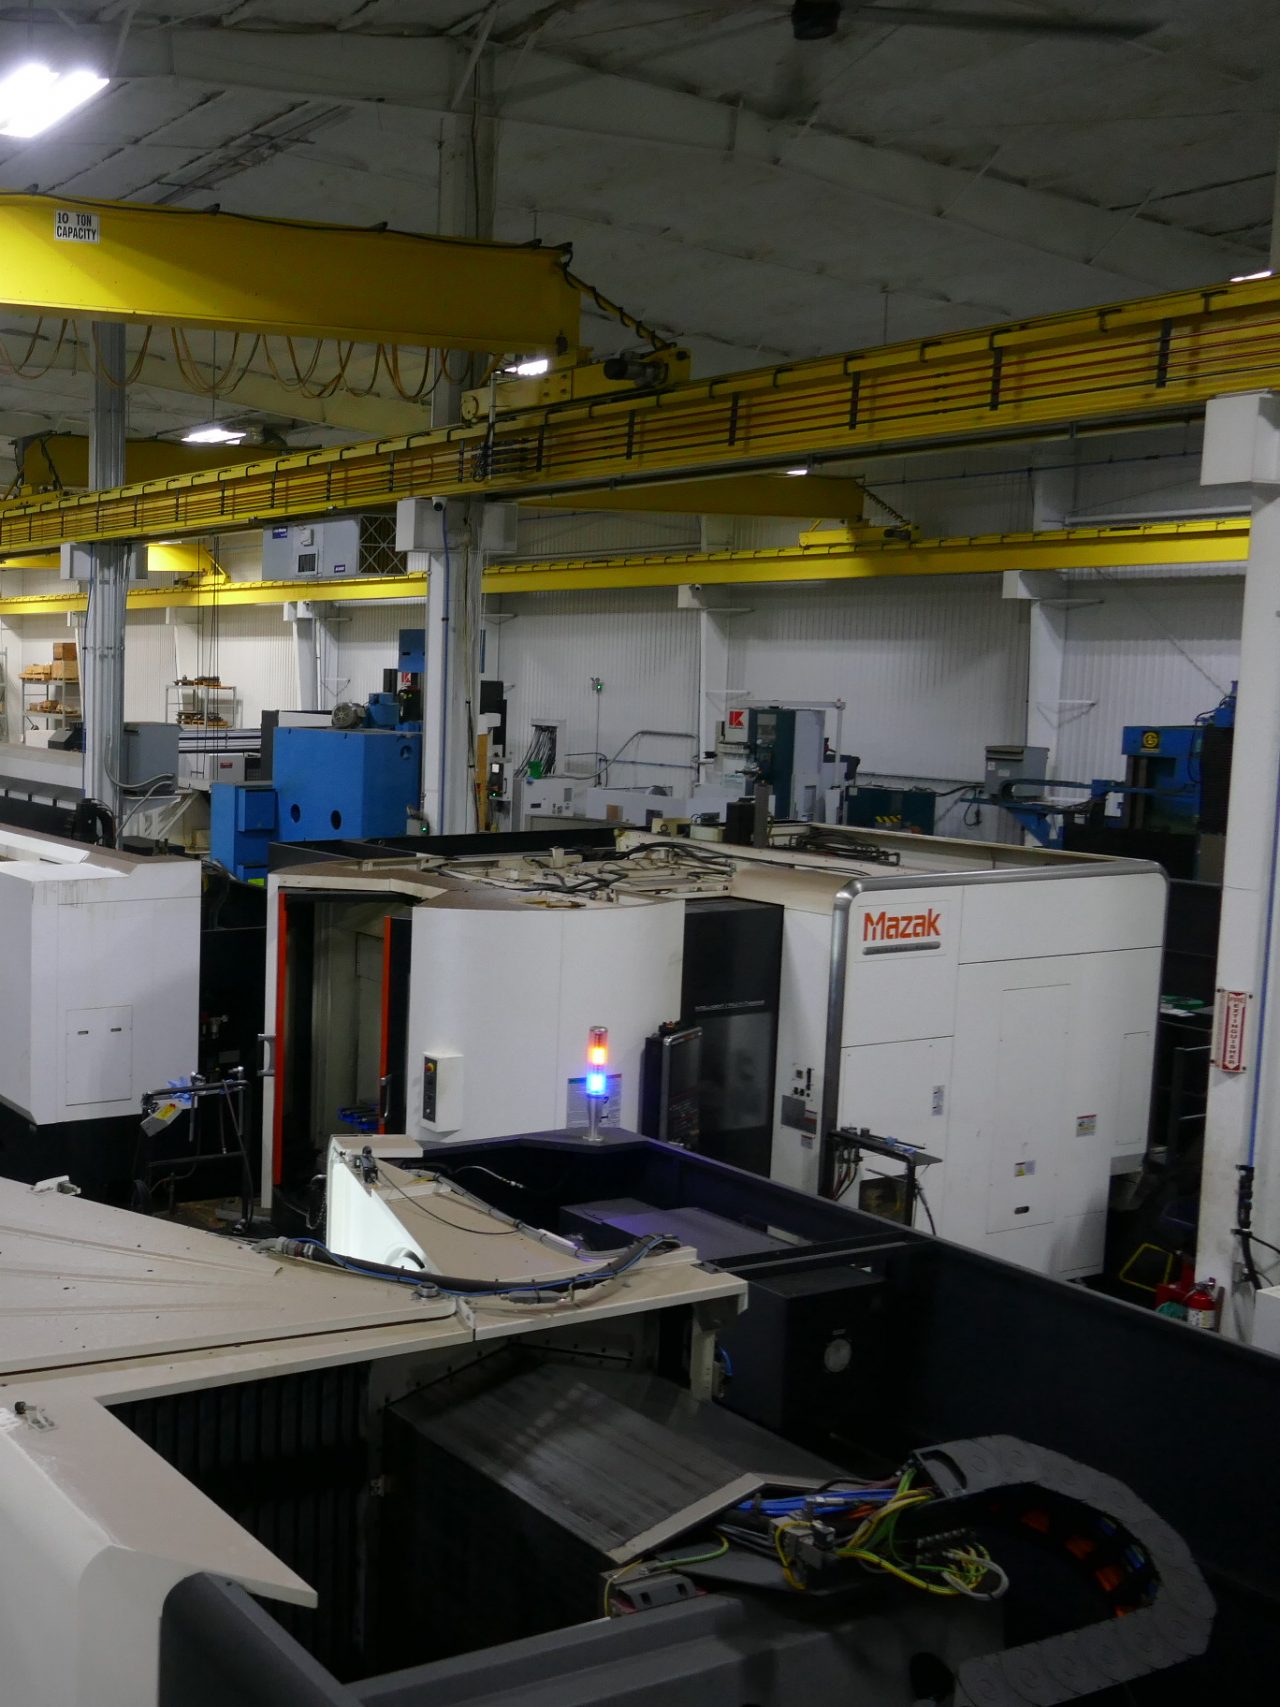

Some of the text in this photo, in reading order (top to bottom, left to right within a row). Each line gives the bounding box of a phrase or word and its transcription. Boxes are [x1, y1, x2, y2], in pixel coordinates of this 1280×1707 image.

[57, 212, 92, 227] 10 TON
[56, 225, 97, 240] CAPACITY
[863, 908, 941, 942] Mazak
[1228, 1003, 1239, 1065] EXTINGUISHER
